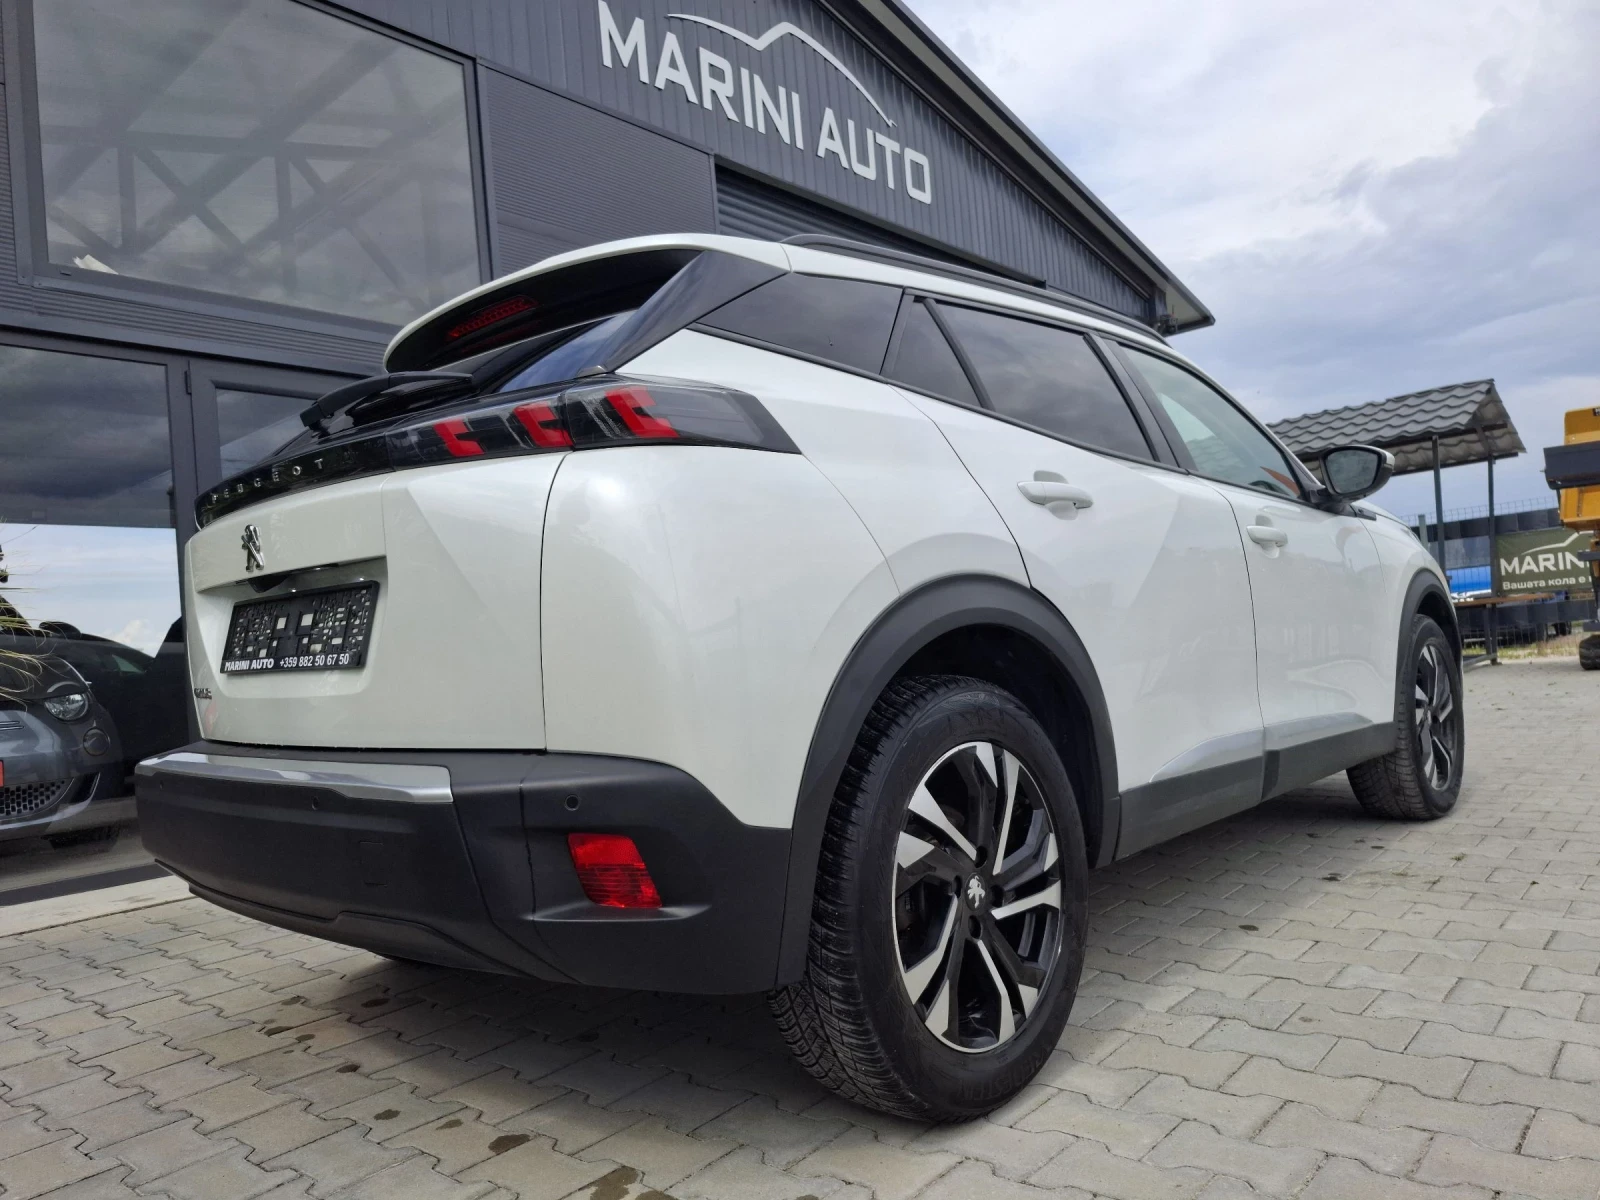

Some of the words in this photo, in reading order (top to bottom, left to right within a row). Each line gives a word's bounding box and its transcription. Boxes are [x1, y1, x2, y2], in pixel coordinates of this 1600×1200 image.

[598, 0, 804, 151] MARINI
[816, 107, 932, 204] AUTO
[211, 458, 324, 504] PEUGEOT
[1502, 578, 1546, 590] Вашата
[1548, 576, 1576, 586] кола
[224, 660, 250, 672] MARINI
[250, 658, 275, 670] AUTO
[280, 657, 298, 668] +359
[298, 656, 313, 667] 882
[314, 655, 326, 666] 50
[326, 654, 338, 665] 67
[338, 653, 350, 665] 50
